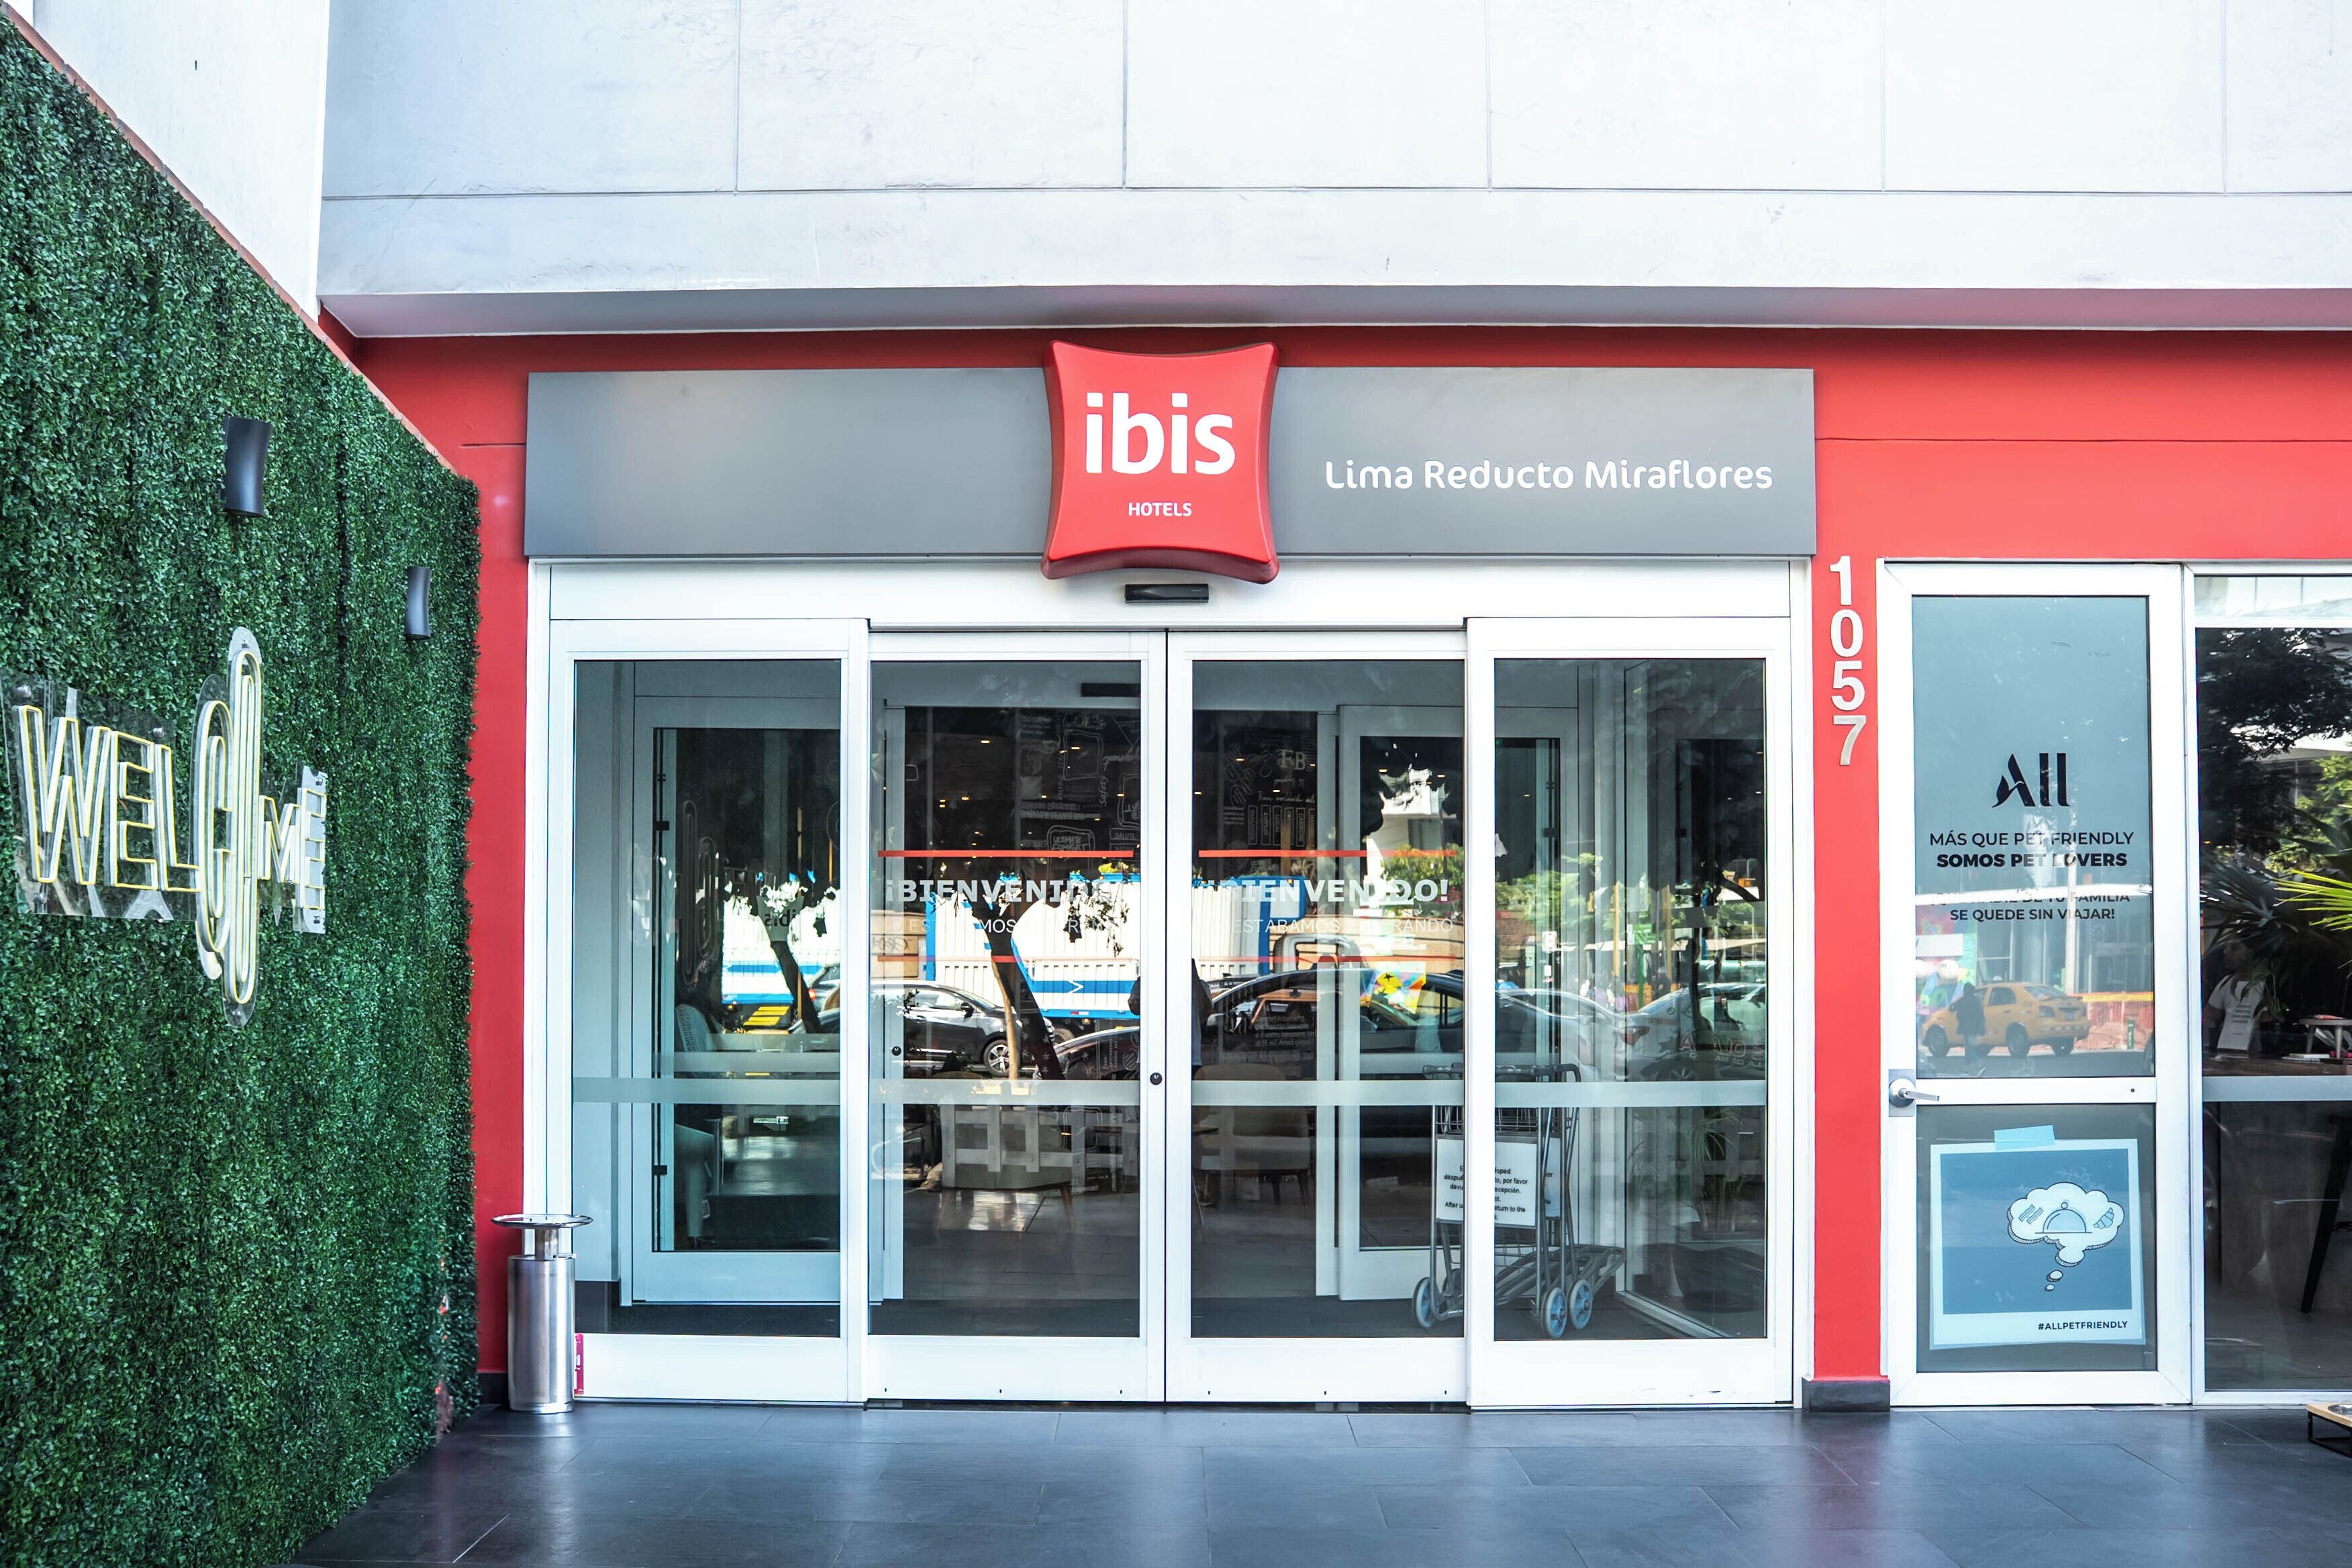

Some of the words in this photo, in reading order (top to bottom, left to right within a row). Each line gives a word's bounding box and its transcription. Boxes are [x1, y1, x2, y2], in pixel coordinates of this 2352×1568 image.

[1085, 392, 1236, 475] ibis
[1325, 459, 1414, 489] Lima
[1424, 459, 1575, 489] Reducto
[1584, 459, 1773, 489] Miraflores
[1128, 502, 1192, 517] HOTELS
[1829, 555, 1867, 766] 1057
[13, 650, 327, 1004] WELCOME
[1930, 830, 1967, 846] MÁS
[1972, 833, 2008, 848] QUE
[2014, 833, 2045, 845] PET
[2051, 832, 2134, 845] FRIENDLY
[1937, 853, 2006, 868] SOMOS
[2011, 853, 2047, 868] PET
[2053, 853, 2127, 868] LOVERS
[1950, 909, 1968, 920] SE
[1972, 909, 2025, 922] QUEDE
[2029, 909, 2053, 920] SIN
[2038, 1320, 2128, 1330] #ALLPETFRIENDLY
